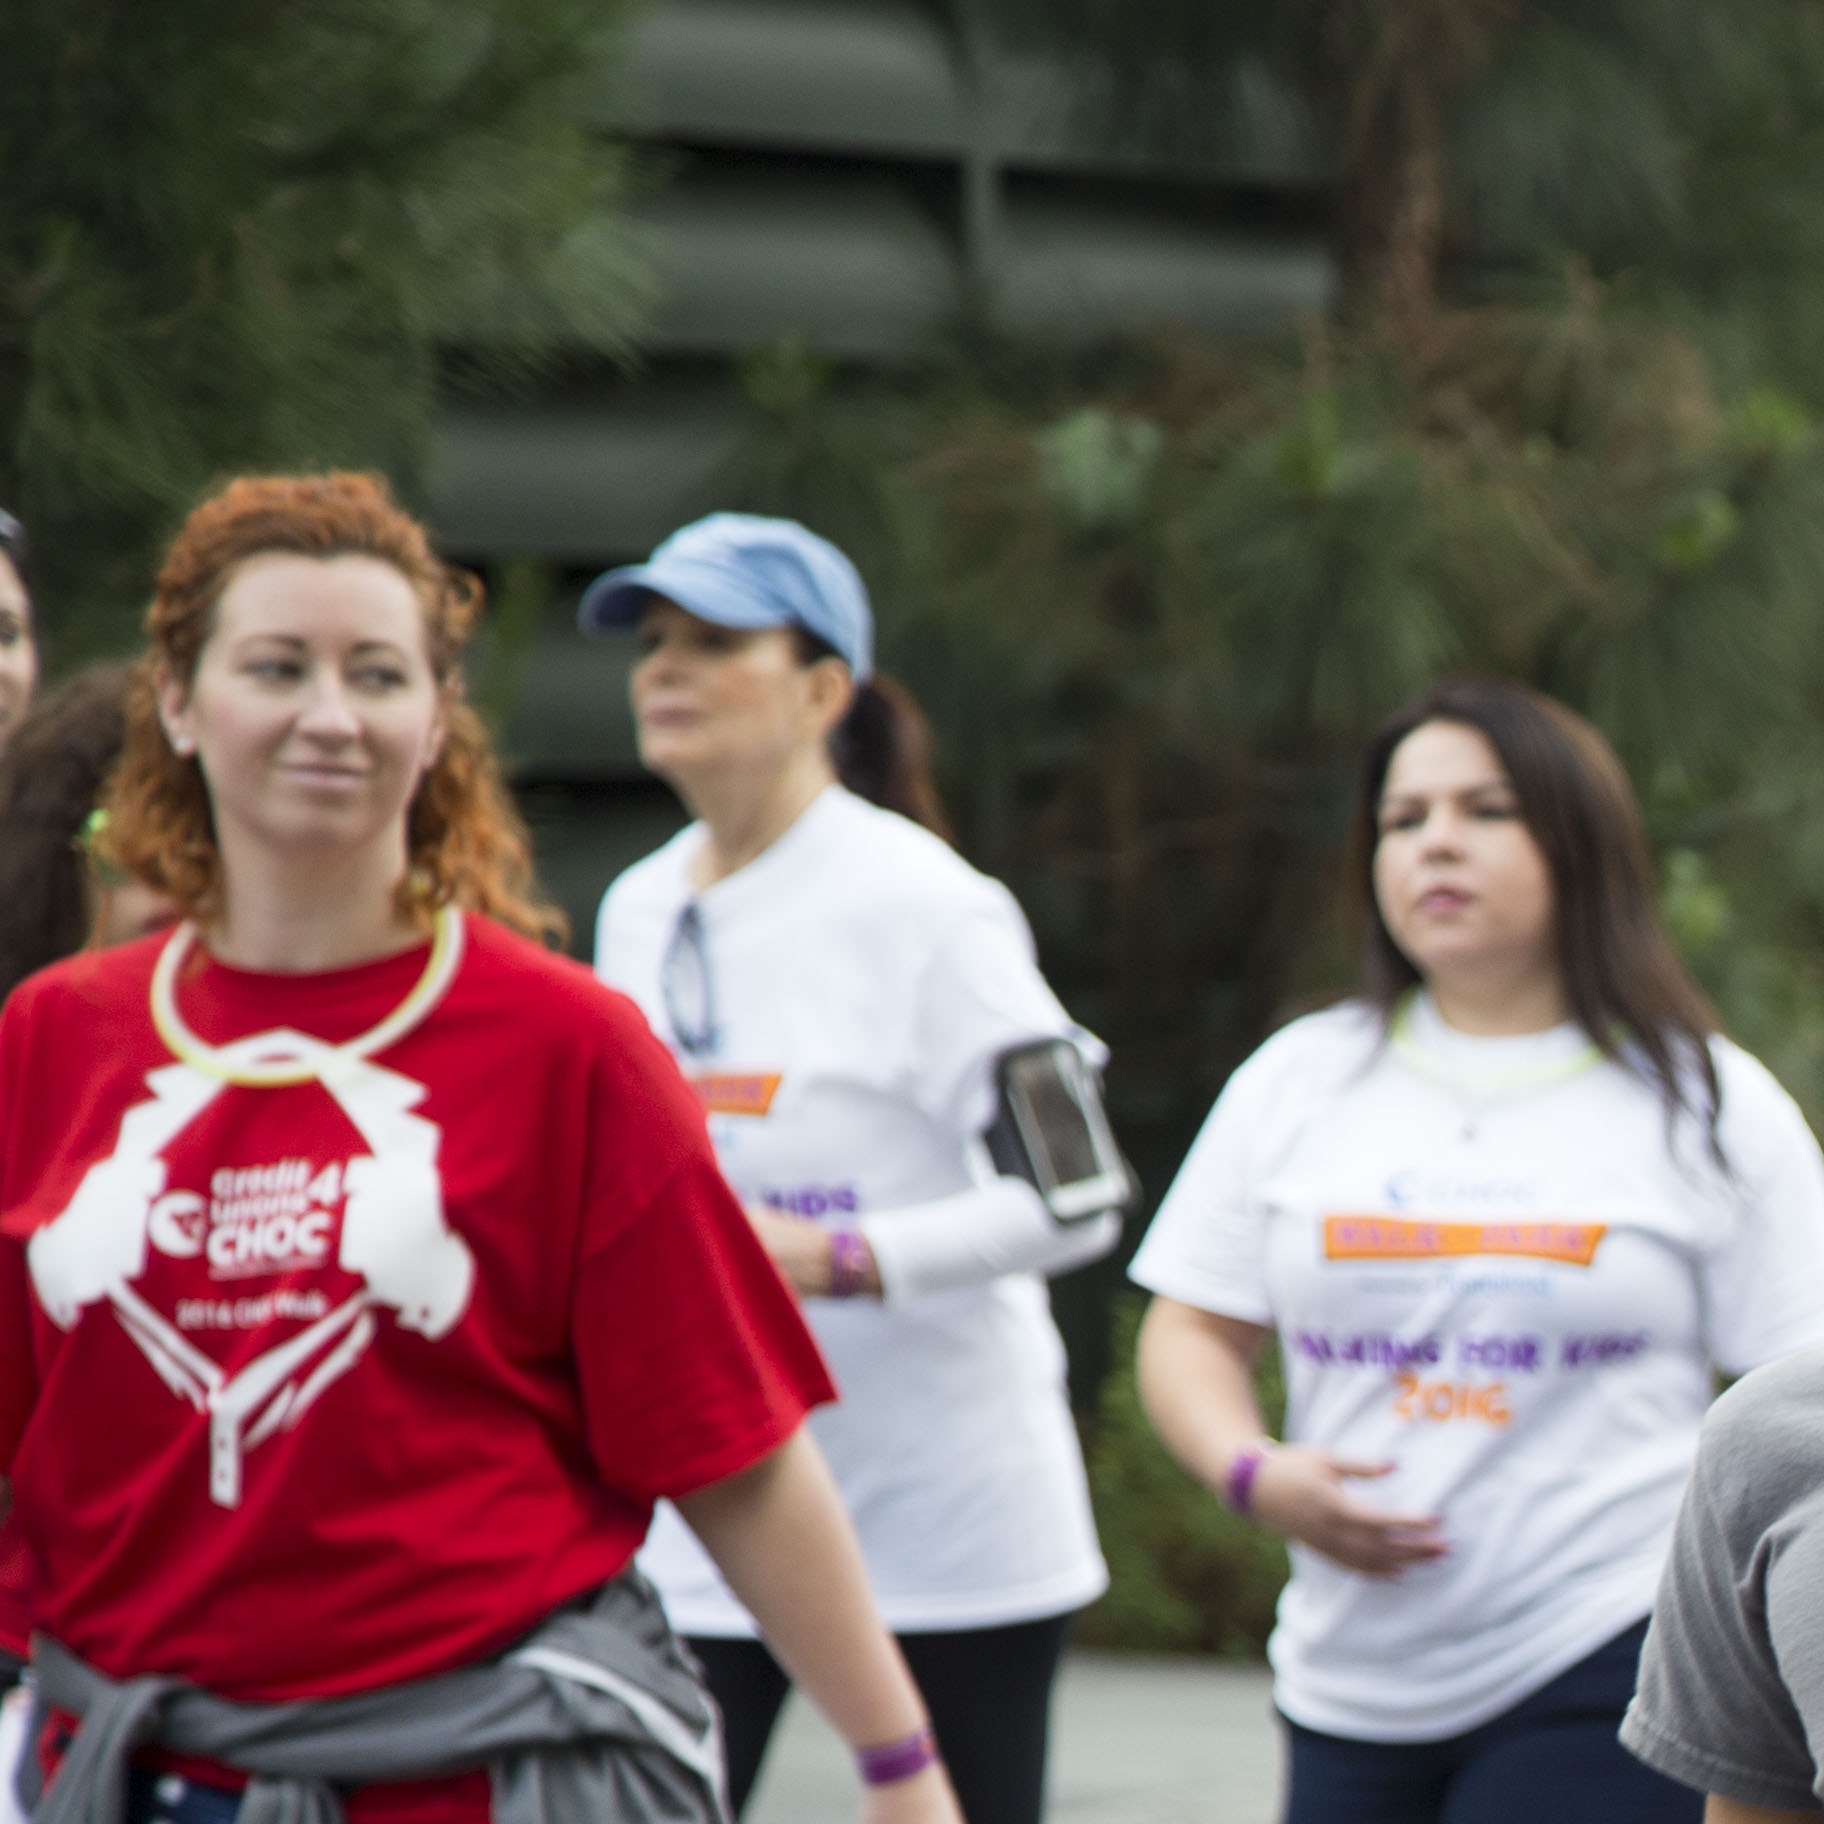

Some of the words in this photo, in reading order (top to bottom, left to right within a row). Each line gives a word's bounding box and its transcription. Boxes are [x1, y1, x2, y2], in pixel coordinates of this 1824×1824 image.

[307, 1162, 341, 1205] 4
[206, 1210, 333, 1268] CHOC
[1394, 1368, 1512, 1430] 2016
